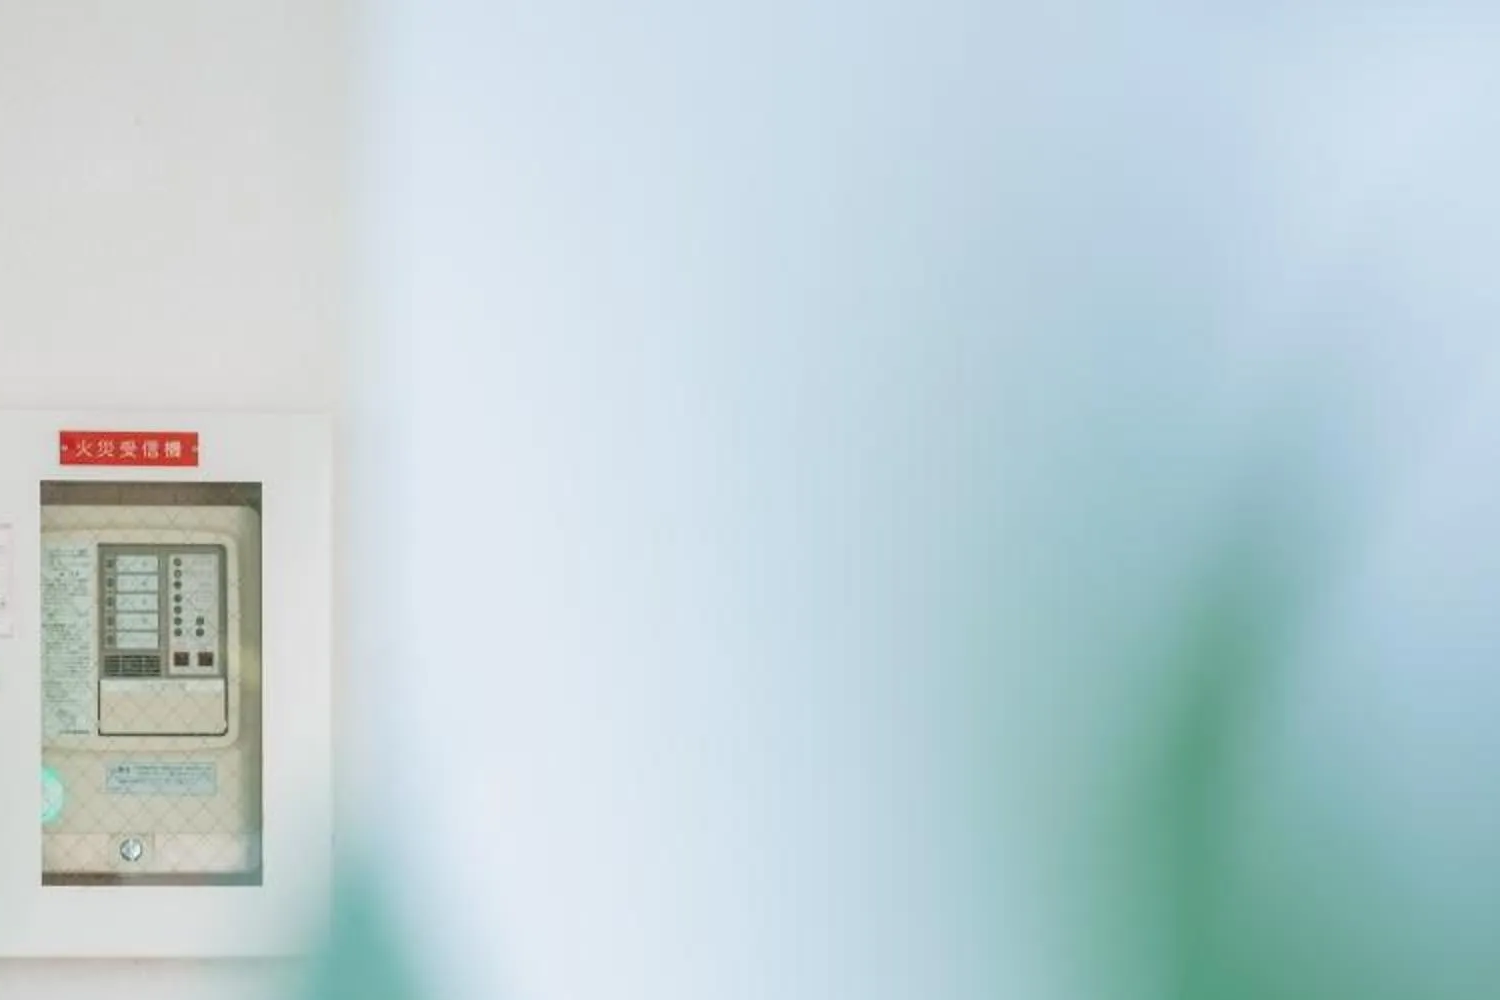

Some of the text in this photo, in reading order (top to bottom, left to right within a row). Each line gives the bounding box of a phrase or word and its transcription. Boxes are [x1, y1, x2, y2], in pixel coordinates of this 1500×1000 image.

[75, 440, 181, 458] 火災受信機
